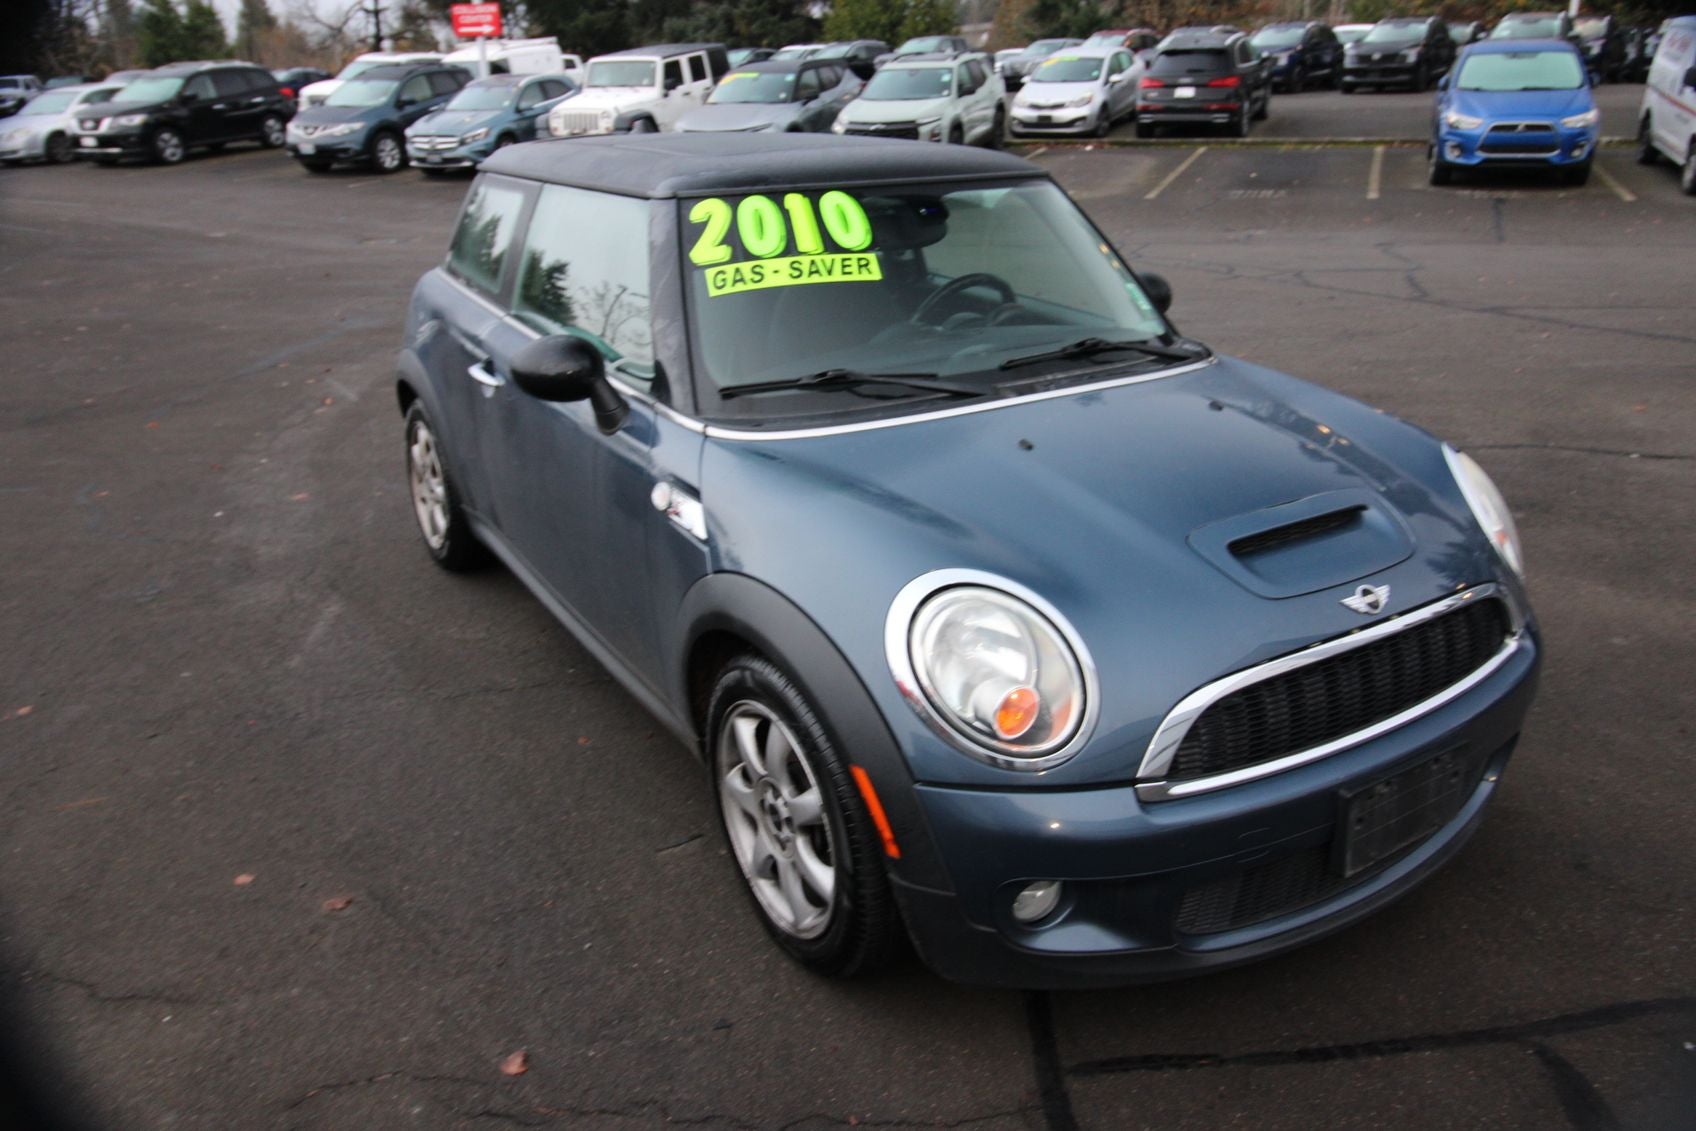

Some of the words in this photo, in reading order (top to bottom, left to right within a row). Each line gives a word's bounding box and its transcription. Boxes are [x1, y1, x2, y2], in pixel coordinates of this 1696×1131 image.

[689, 190, 872, 266] 2010
[713, 264, 766, 290] GAS
[788, 257, 873, 280] SAVER
